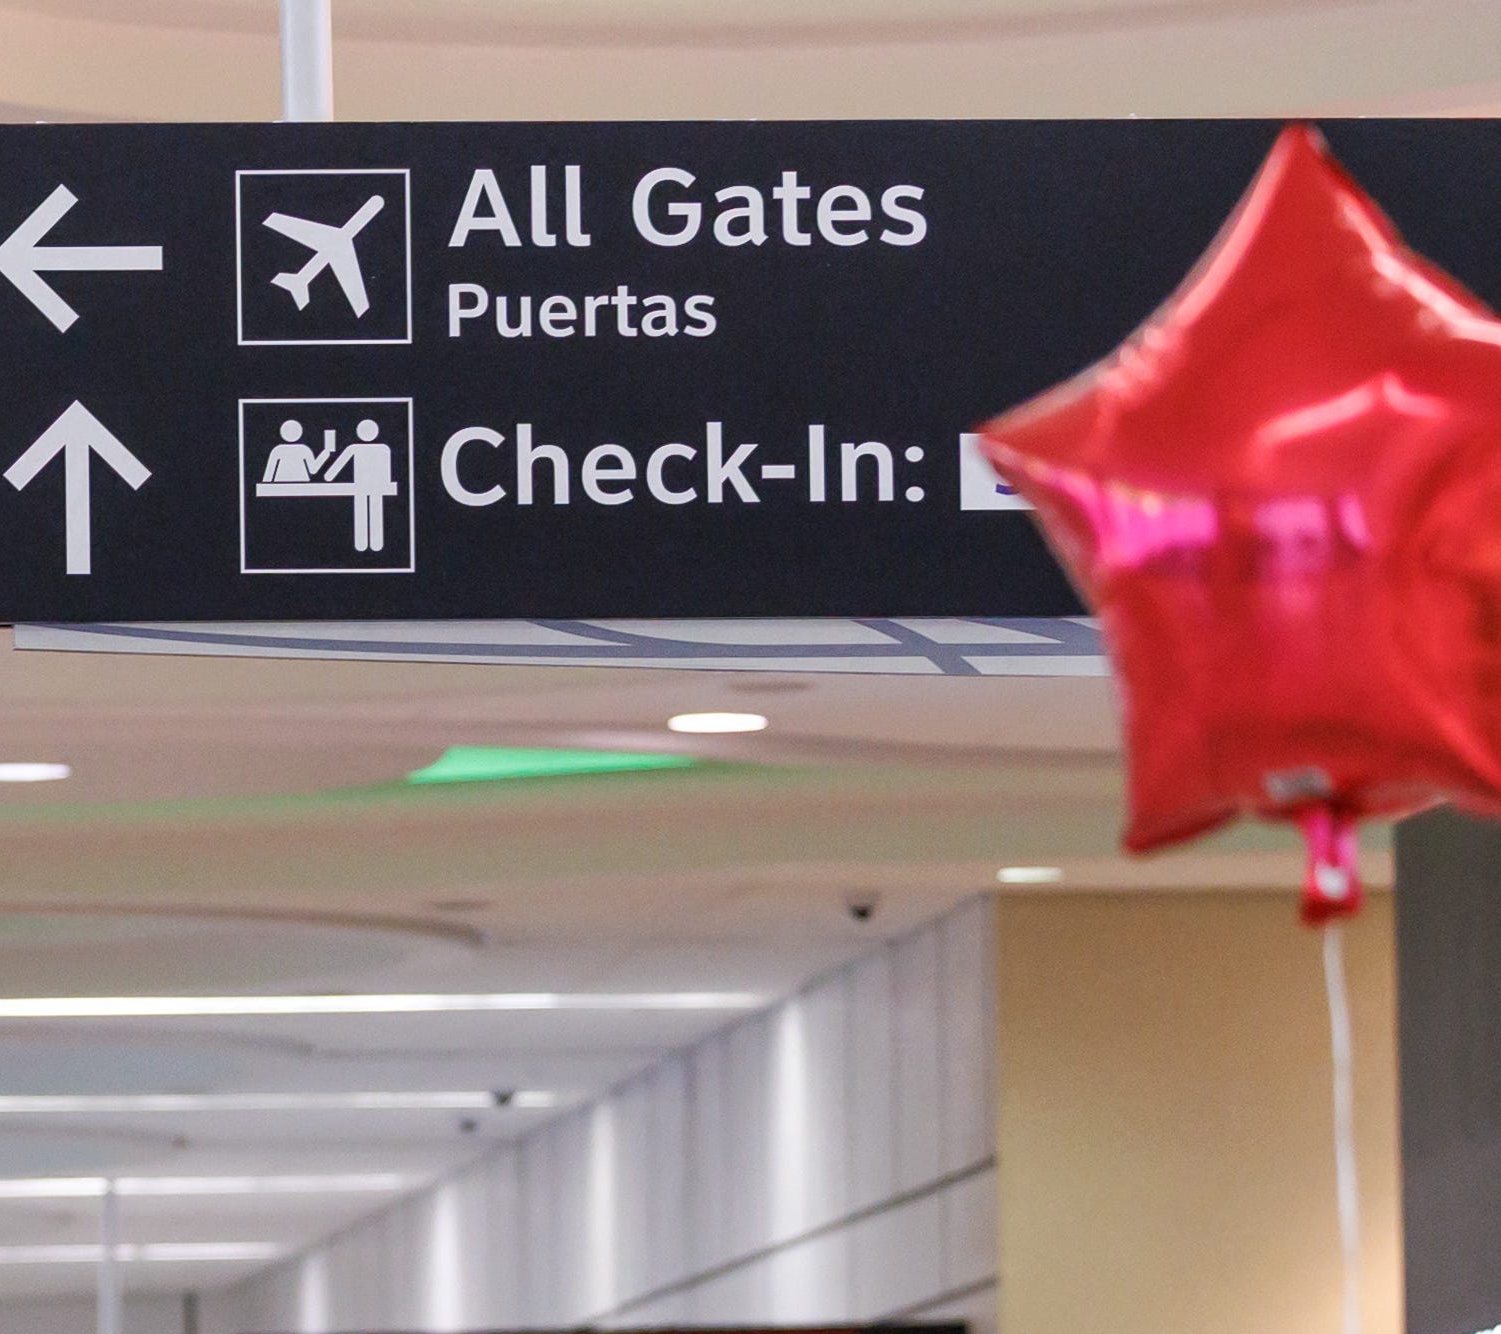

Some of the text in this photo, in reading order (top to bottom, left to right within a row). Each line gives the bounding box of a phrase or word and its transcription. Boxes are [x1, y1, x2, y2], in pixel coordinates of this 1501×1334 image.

[448, 164, 927, 248] All Gates
[448, 282, 718, 339] Puertas
[439, 421, 926, 508] Check-In:
